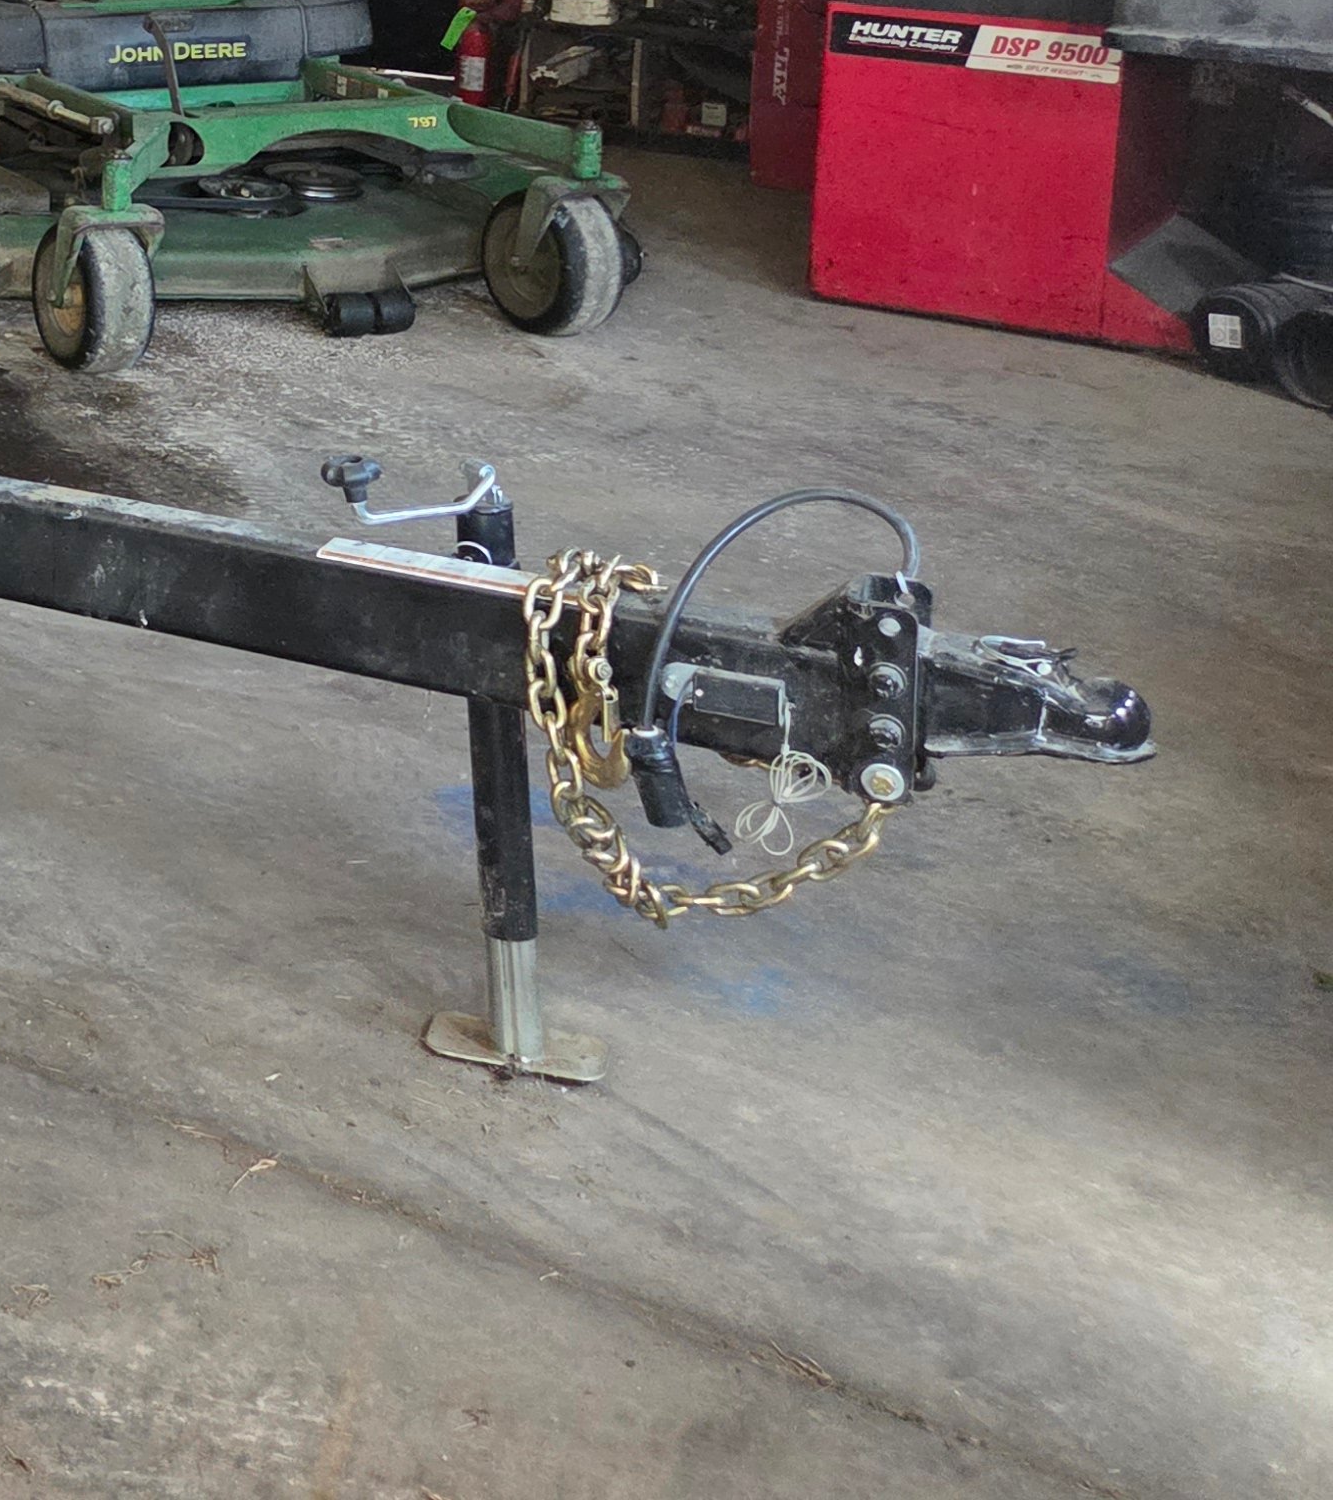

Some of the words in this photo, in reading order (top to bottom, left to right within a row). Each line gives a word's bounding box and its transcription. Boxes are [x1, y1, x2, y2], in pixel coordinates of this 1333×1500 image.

[848, 33, 908, 48] Engineering
[908, 40, 959, 52] Company
[851, 20, 963, 44] HUNTER
[108, 44, 164, 64] JOHN
[174, 41, 247, 61] DEERE
[990, 35, 1041, 57] DSP
[1045, 41, 1110, 65] 9500
